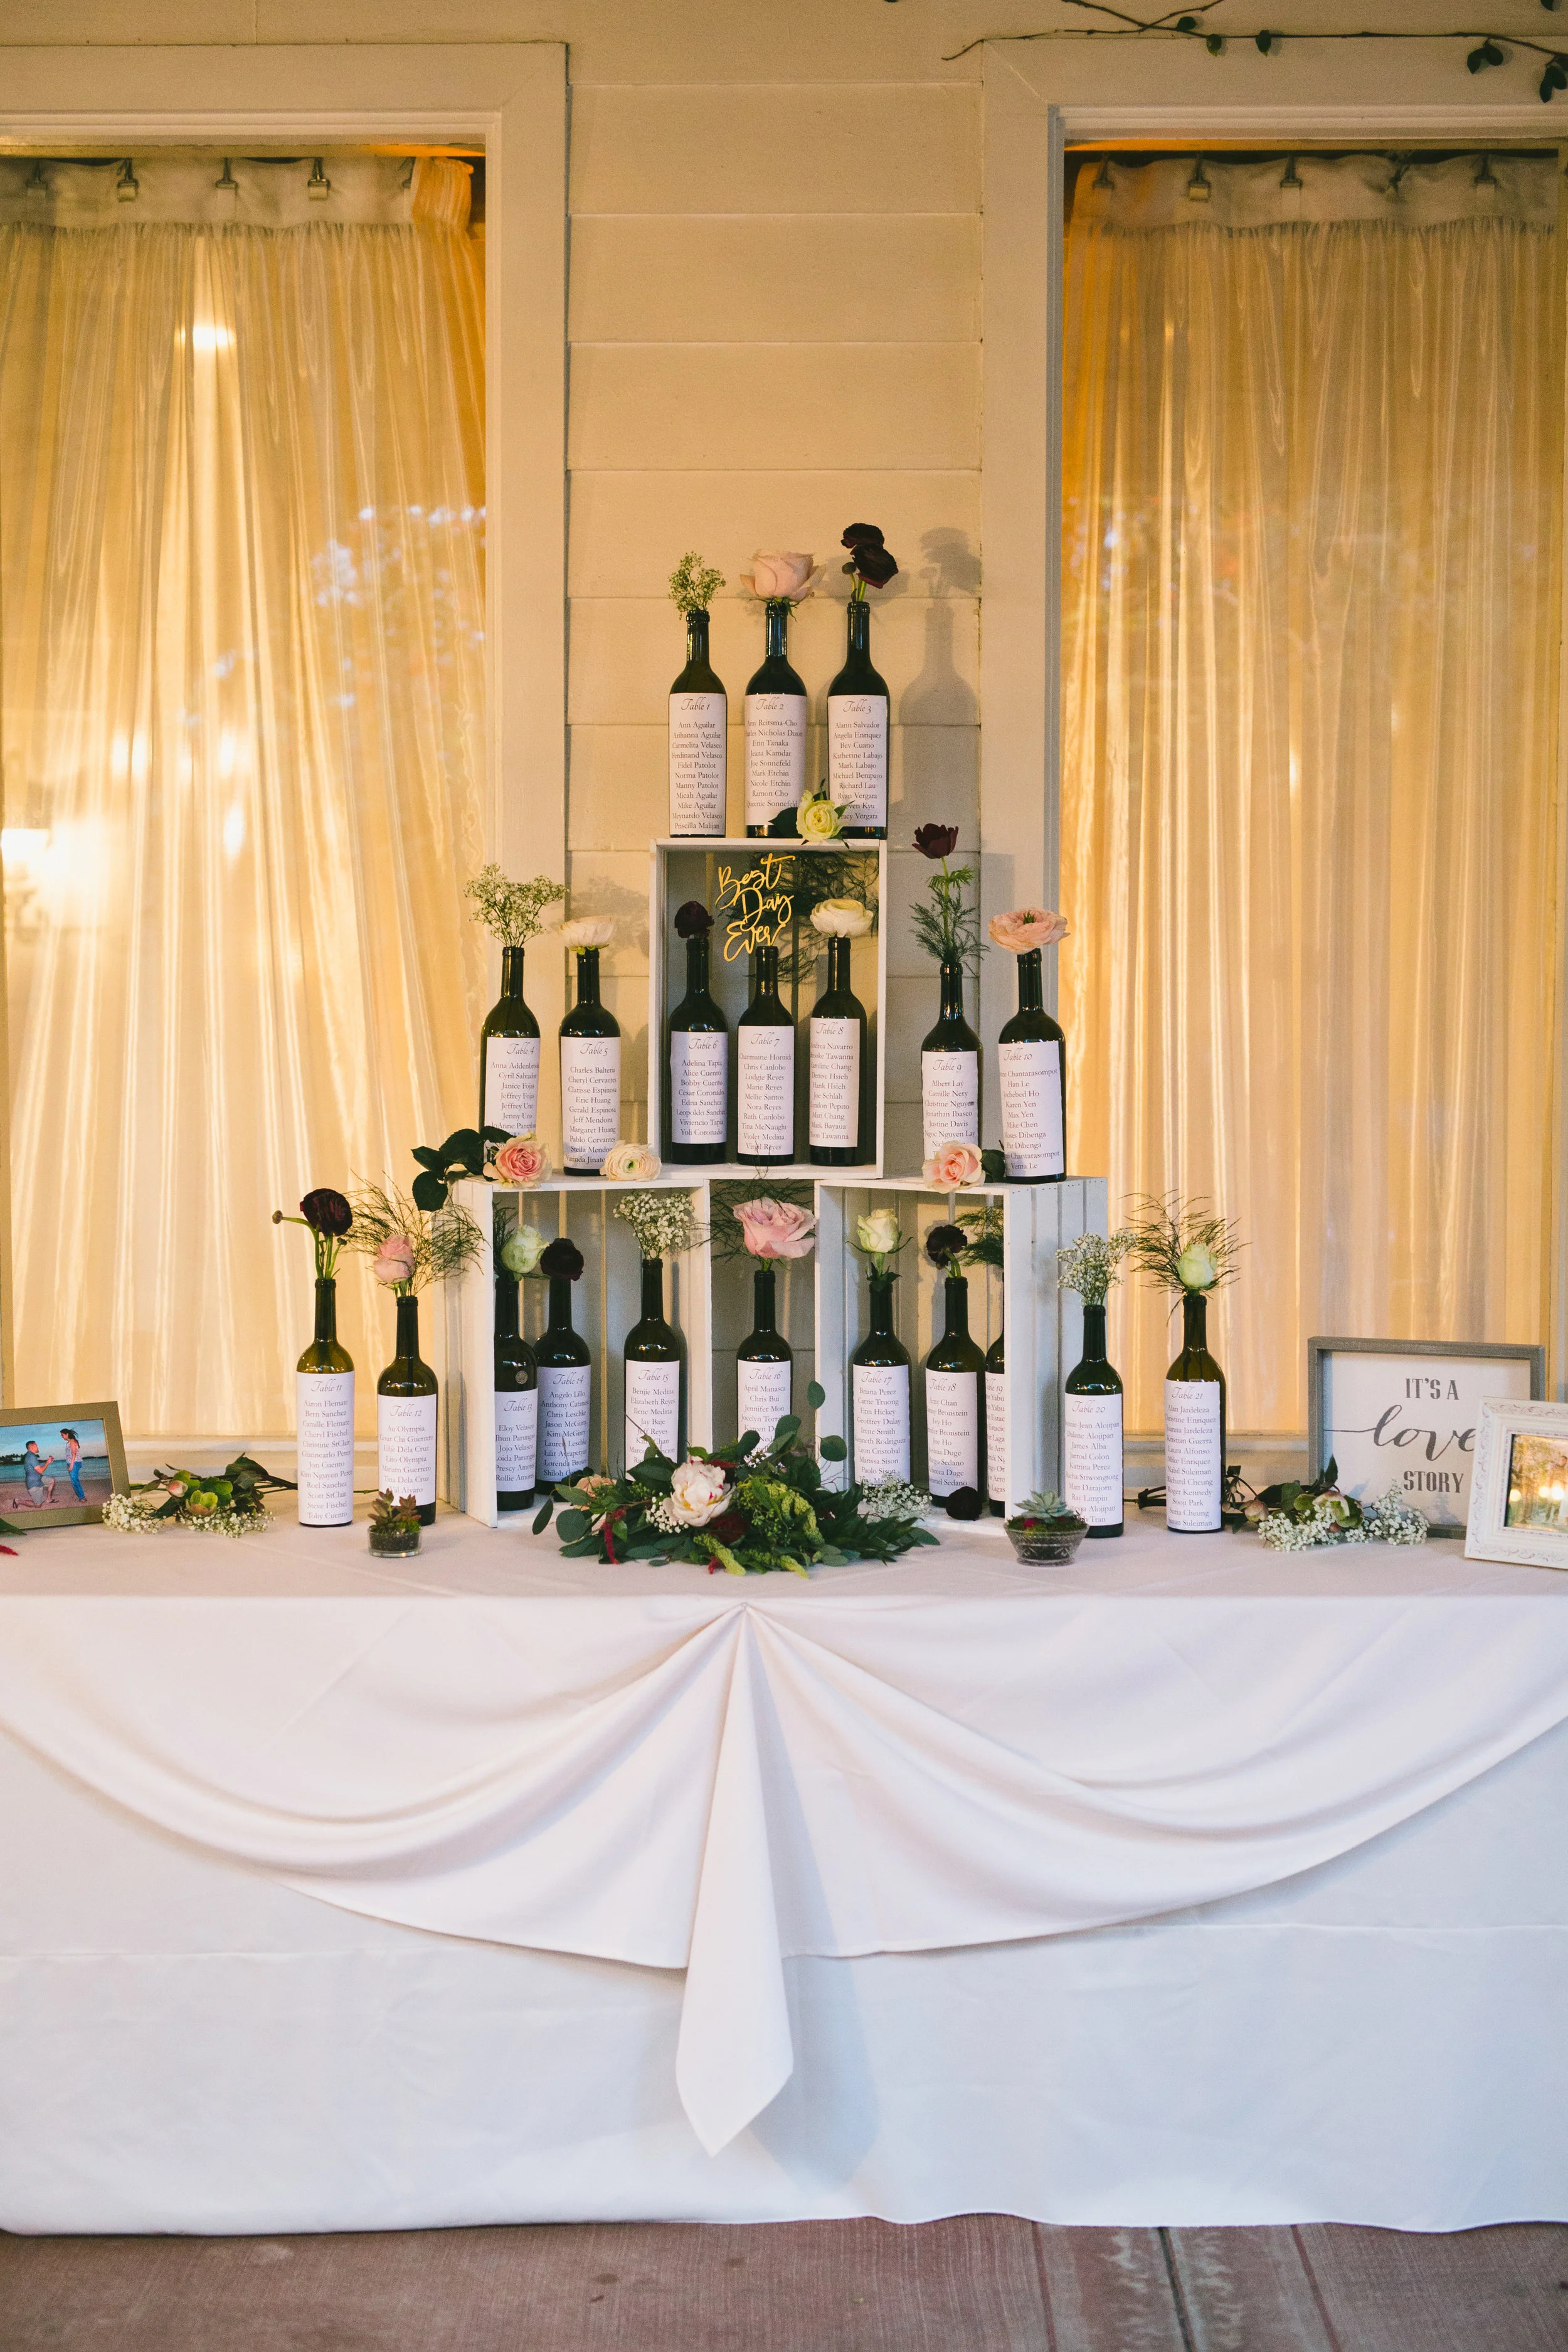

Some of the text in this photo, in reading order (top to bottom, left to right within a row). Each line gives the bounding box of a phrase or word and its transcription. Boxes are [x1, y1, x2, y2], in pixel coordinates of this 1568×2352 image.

[681, 697, 706, 711] Table
[756, 697, 779, 710] Table
[844, 699, 867, 712] Table
[715, 853, 795, 909] Best
[737, 887, 794, 931] Day
[724, 920, 786, 961] Ever
[816, 1022, 837, 1034] Table
[689, 1036, 712, 1049] Table
[751, 1032, 774, 1045] Table
[507, 1042, 530, 1054] Table
[580, 1042, 608, 1056] Table 5
[1004, 1048, 1023, 1061] Table
[933, 1057, 961, 1073] Table 9
[553, 1372, 584, 1385] Table 14
[638, 1368, 663, 1380] Table
[750, 1367, 781, 1380] Table 16
[861, 1372, 882, 1384] Table
[311, 1379, 336, 1392] Table
[929, 1378, 956, 1391] Table 18
[1406, 1378, 1459, 1400] IT'S A
[633, 1387, 650, 1396] Benjie
[1172, 1387, 1194, 1399] Table
[504, 1398, 527, 1412] Table
[744, 1405, 770, 1413] Jennifer
[876, 1398, 899, 1407] Truong
[1072, 1400, 1095, 1412] Table
[390, 1404, 414, 1417] Table
[874, 1408, 896, 1416] Hickey
[398, 1426, 425, 1434] Olympia
[1342, 1404, 1475, 1461] love
[933, 1439, 941, 1447] Joe
[400, 1456, 426, 1464] Olympia
[1404, 1470, 1464, 1493] STORY
